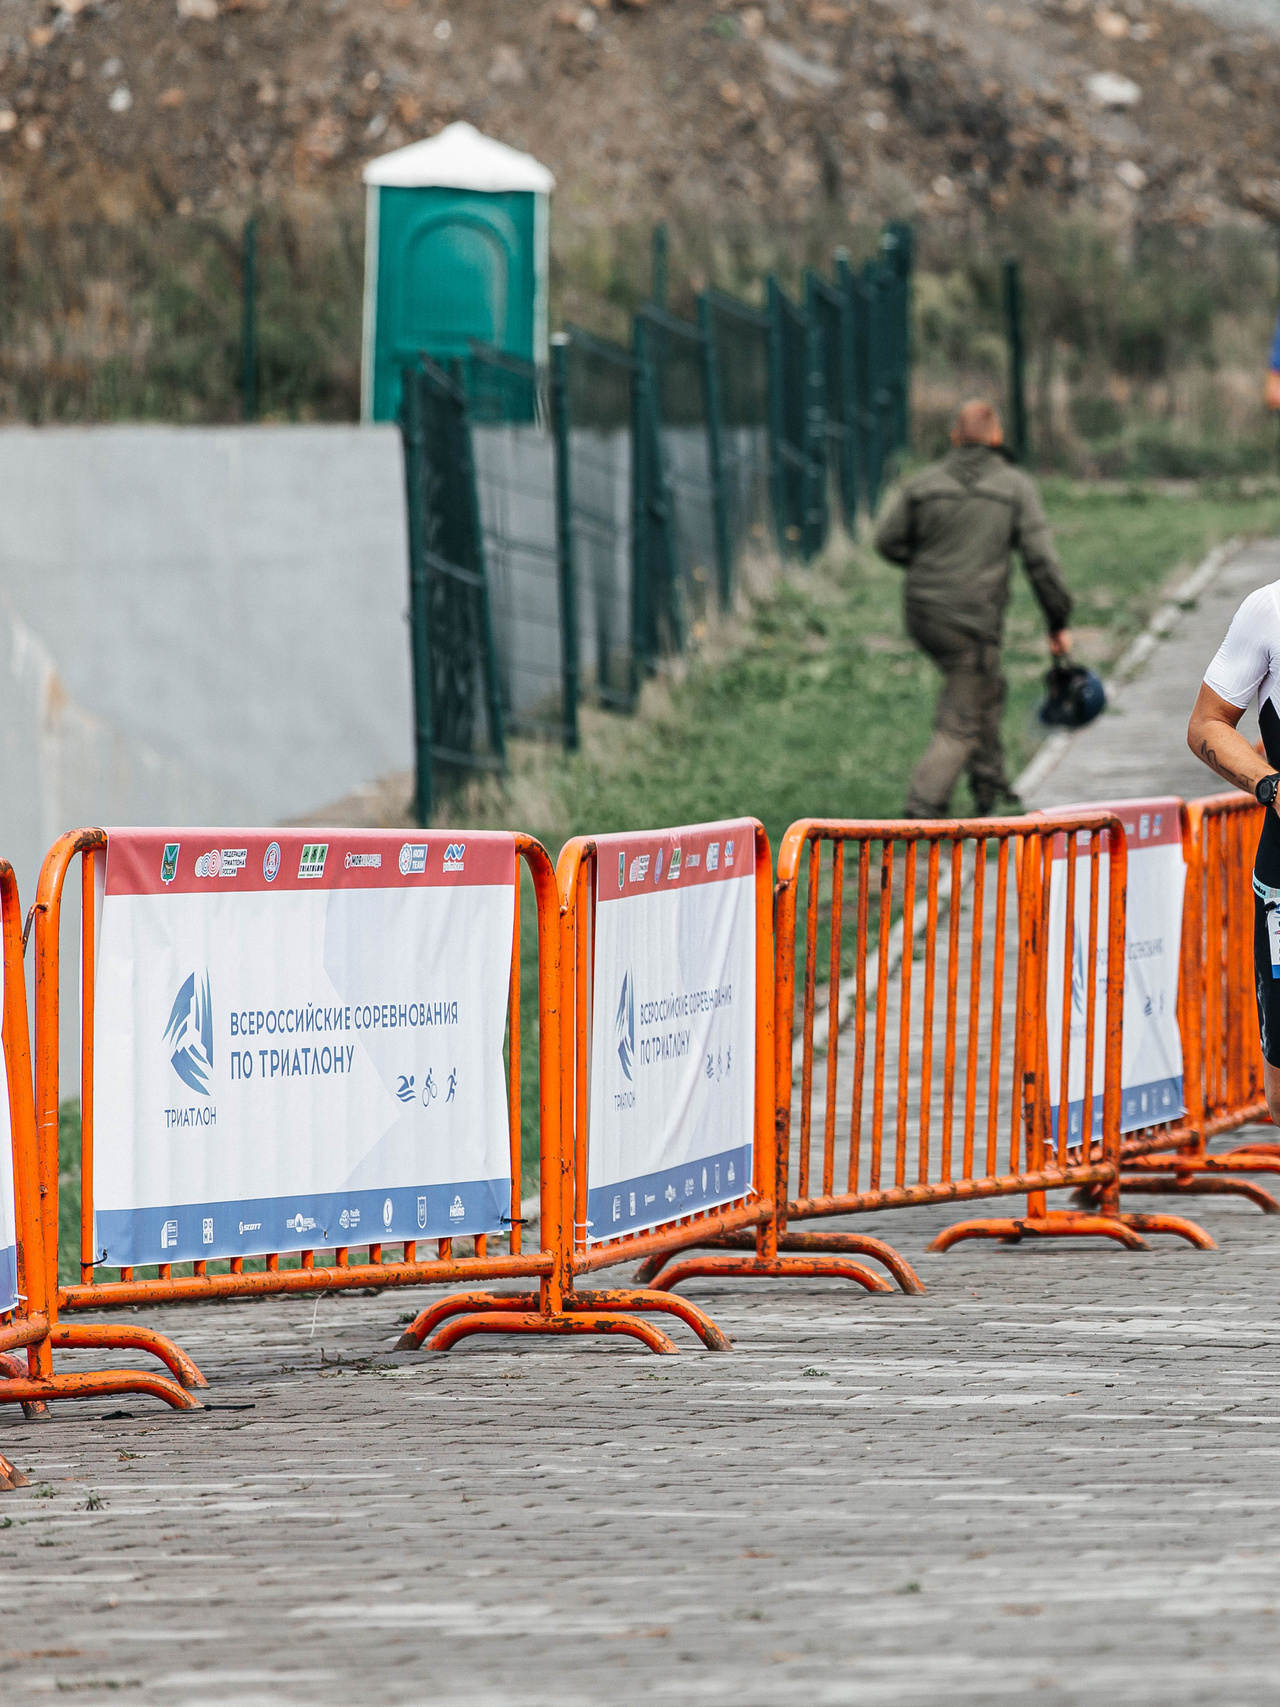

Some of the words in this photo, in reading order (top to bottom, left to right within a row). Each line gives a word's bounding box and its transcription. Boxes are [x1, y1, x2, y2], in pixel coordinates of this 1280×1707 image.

[230, 1002, 351, 1036] ВСЕРОССИЙСКИЕ
[354, 1001, 459, 1030] СОРЕВНОВАНИЯ
[640, 992, 688, 1026] ВСЕРОССИЙСКИЕ
[231, 1050, 253, 1080] ПО
[258, 1045, 355, 1078] ТРИАТЛОНУ
[640, 1039, 651, 1066] ПО
[652, 1029, 691, 1063] ТРИАТЛОНУ
[164, 1106, 217, 1128] ТРИАТЛОН
[243, 1222, 262, 1231] SCOTT
